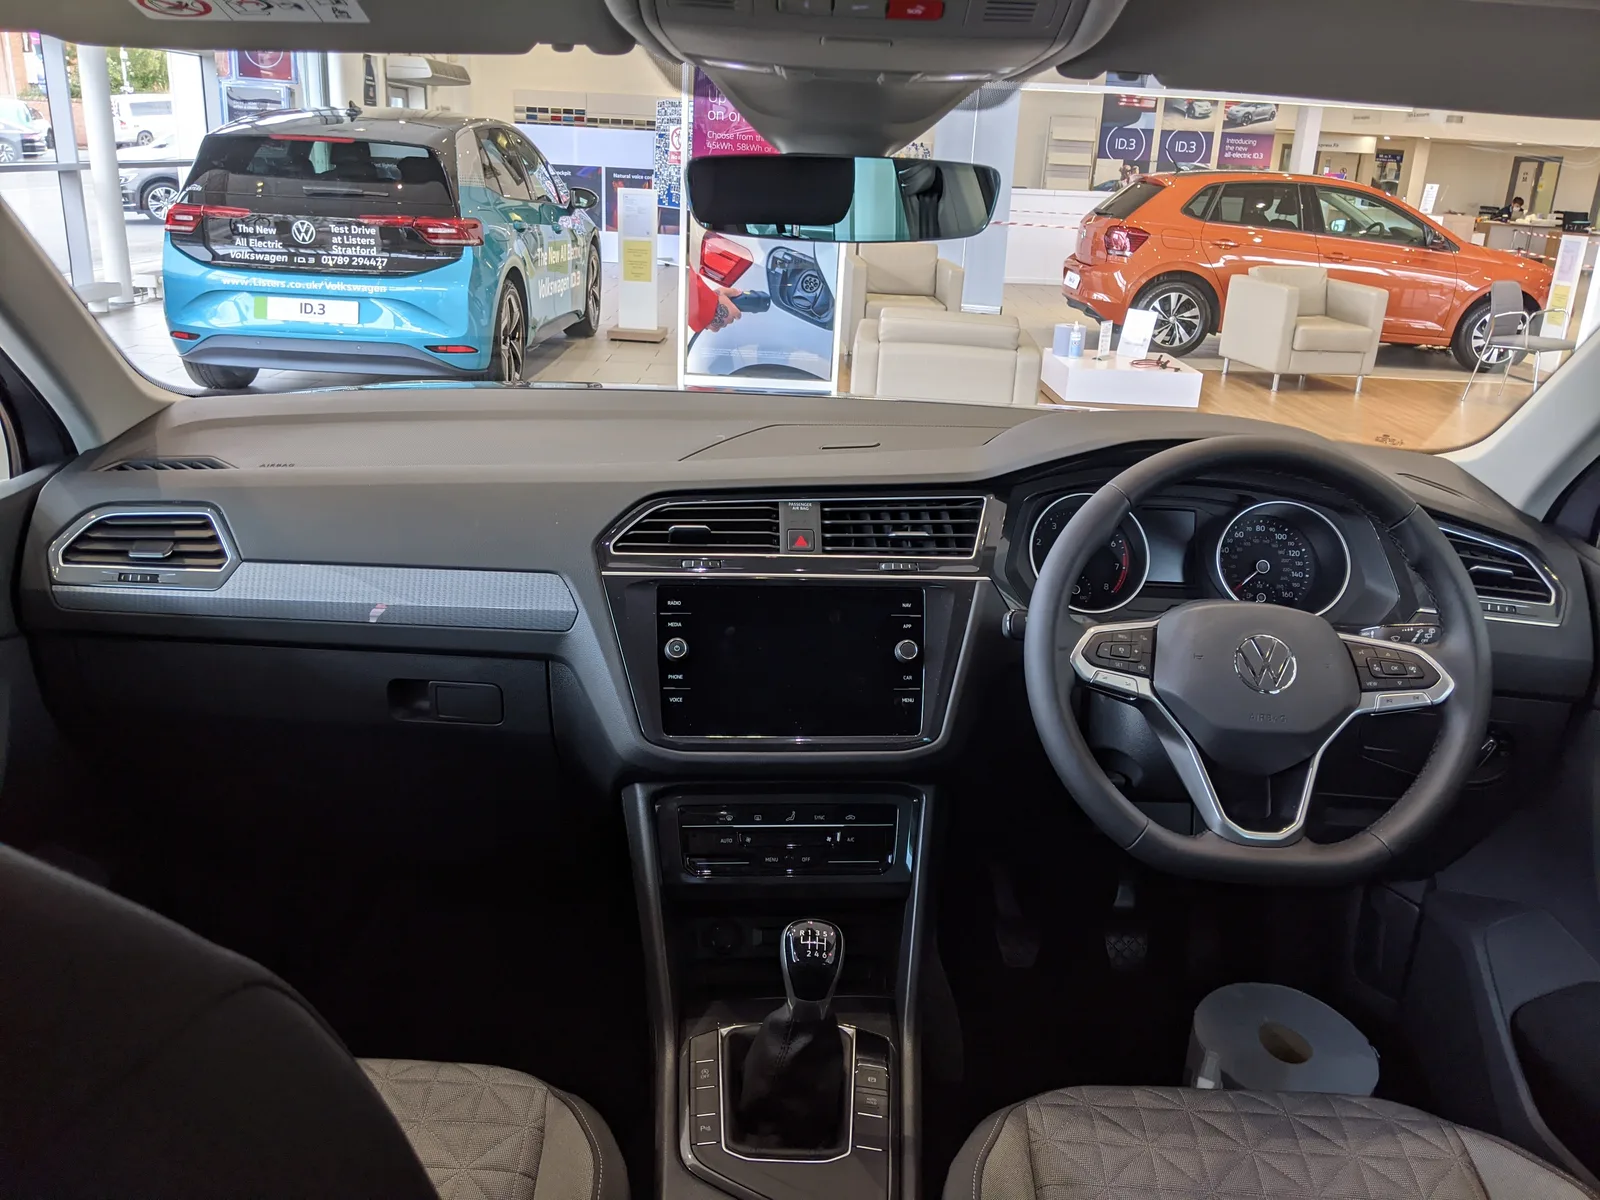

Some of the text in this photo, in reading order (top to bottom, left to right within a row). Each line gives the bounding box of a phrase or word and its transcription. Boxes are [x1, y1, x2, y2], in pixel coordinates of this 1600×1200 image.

[707, 110, 725, 121] on
[707, 130, 735, 140] Choose
[736, 132, 754, 141] from
[1114, 138, 1137, 150] ID.3
[1175, 141, 1197, 153] ID.3
[1226, 137, 1258, 146] Introducing
[736, 143, 763, 152] 58kWh
[236, 224, 277, 235] The New
[329, 224, 377, 235] Test Drive
[235, 238, 283, 249] All Electric
[332, 236, 376, 245] at Listers
[332, 245, 377, 255] Stratford
[230, 251, 289, 264] Volkswagen
[321, 256, 388, 267] 01789 294477
[299, 302, 326, 315] ID.3
[1051, 522, 1057, 530] 3
[1036, 538, 1042, 546] 2
[1110, 540, 1116, 548] 6
[1103, 583, 1109, 591] 8
[822, 951, 827, 959] 6
